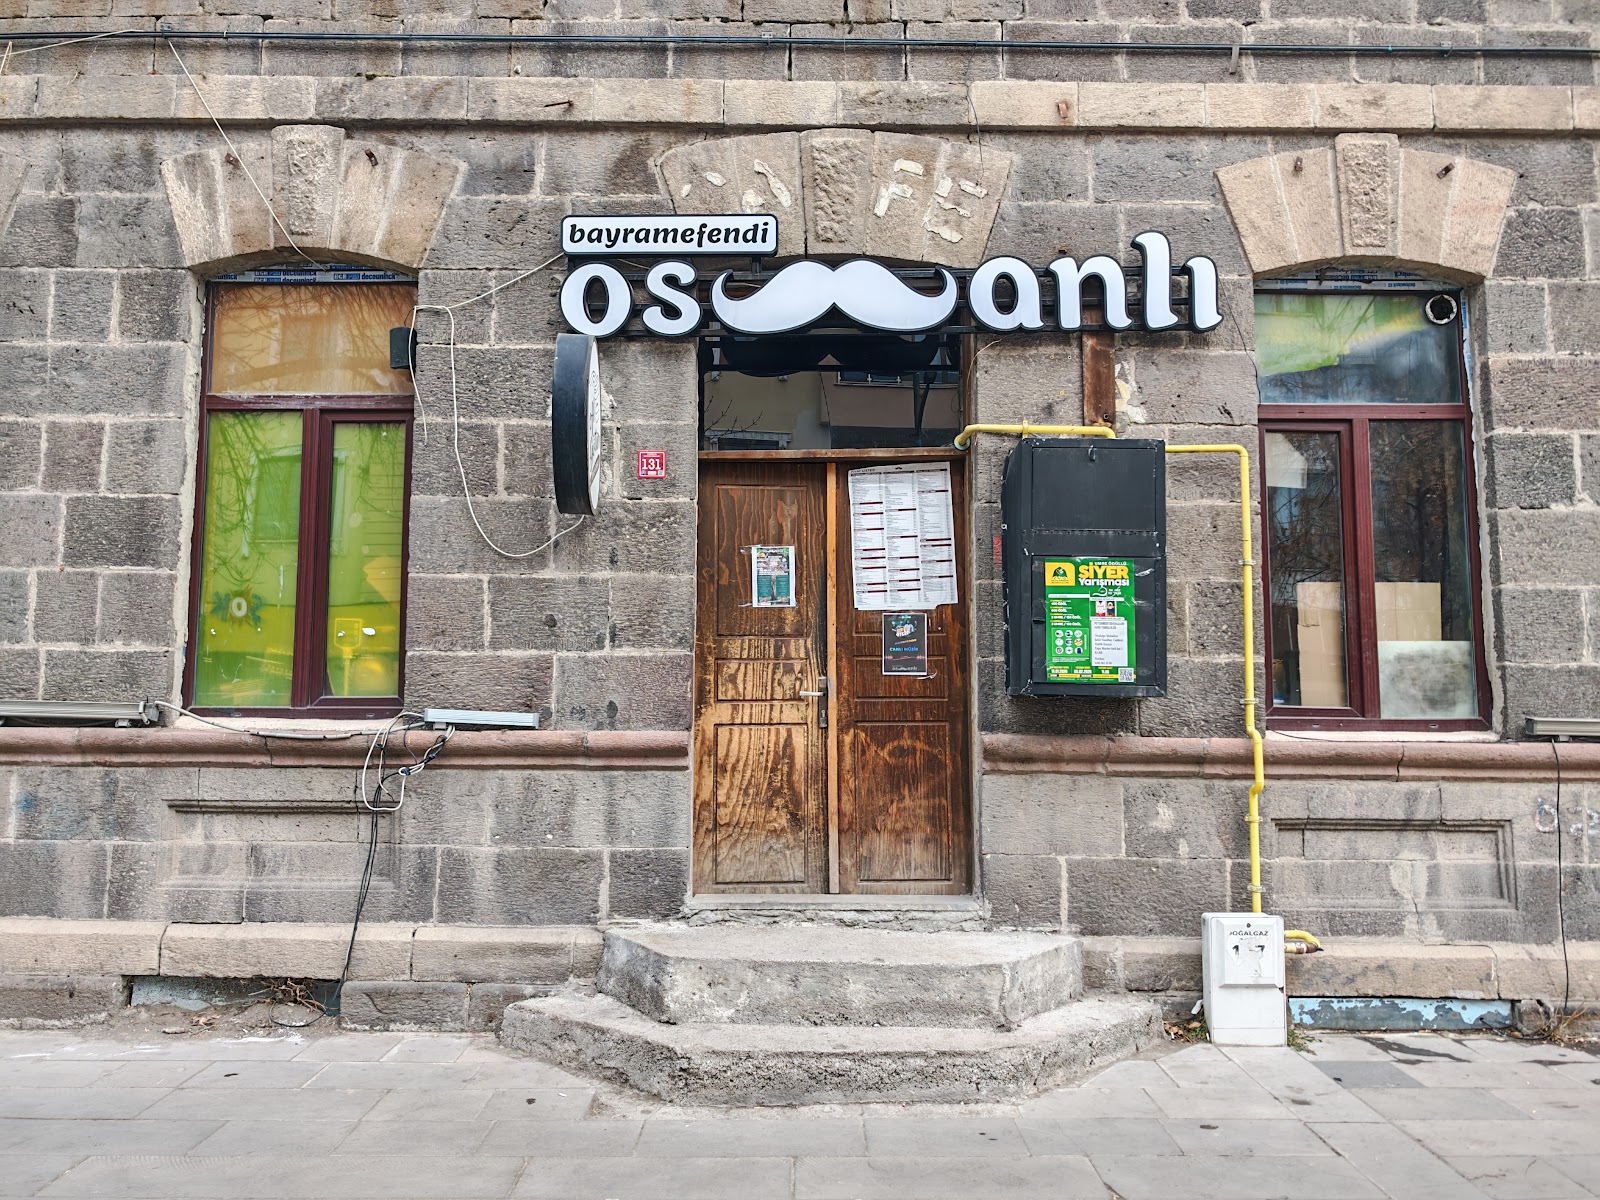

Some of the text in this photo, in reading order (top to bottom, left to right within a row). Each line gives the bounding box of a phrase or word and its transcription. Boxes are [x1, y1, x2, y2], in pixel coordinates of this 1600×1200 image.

[569, 221, 769, 249] bayramefendi
[642, 458, 661, 470] 131
[1078, 562, 1130, 579] SİYER
[1078, 578, 1130, 588] Yarışması
